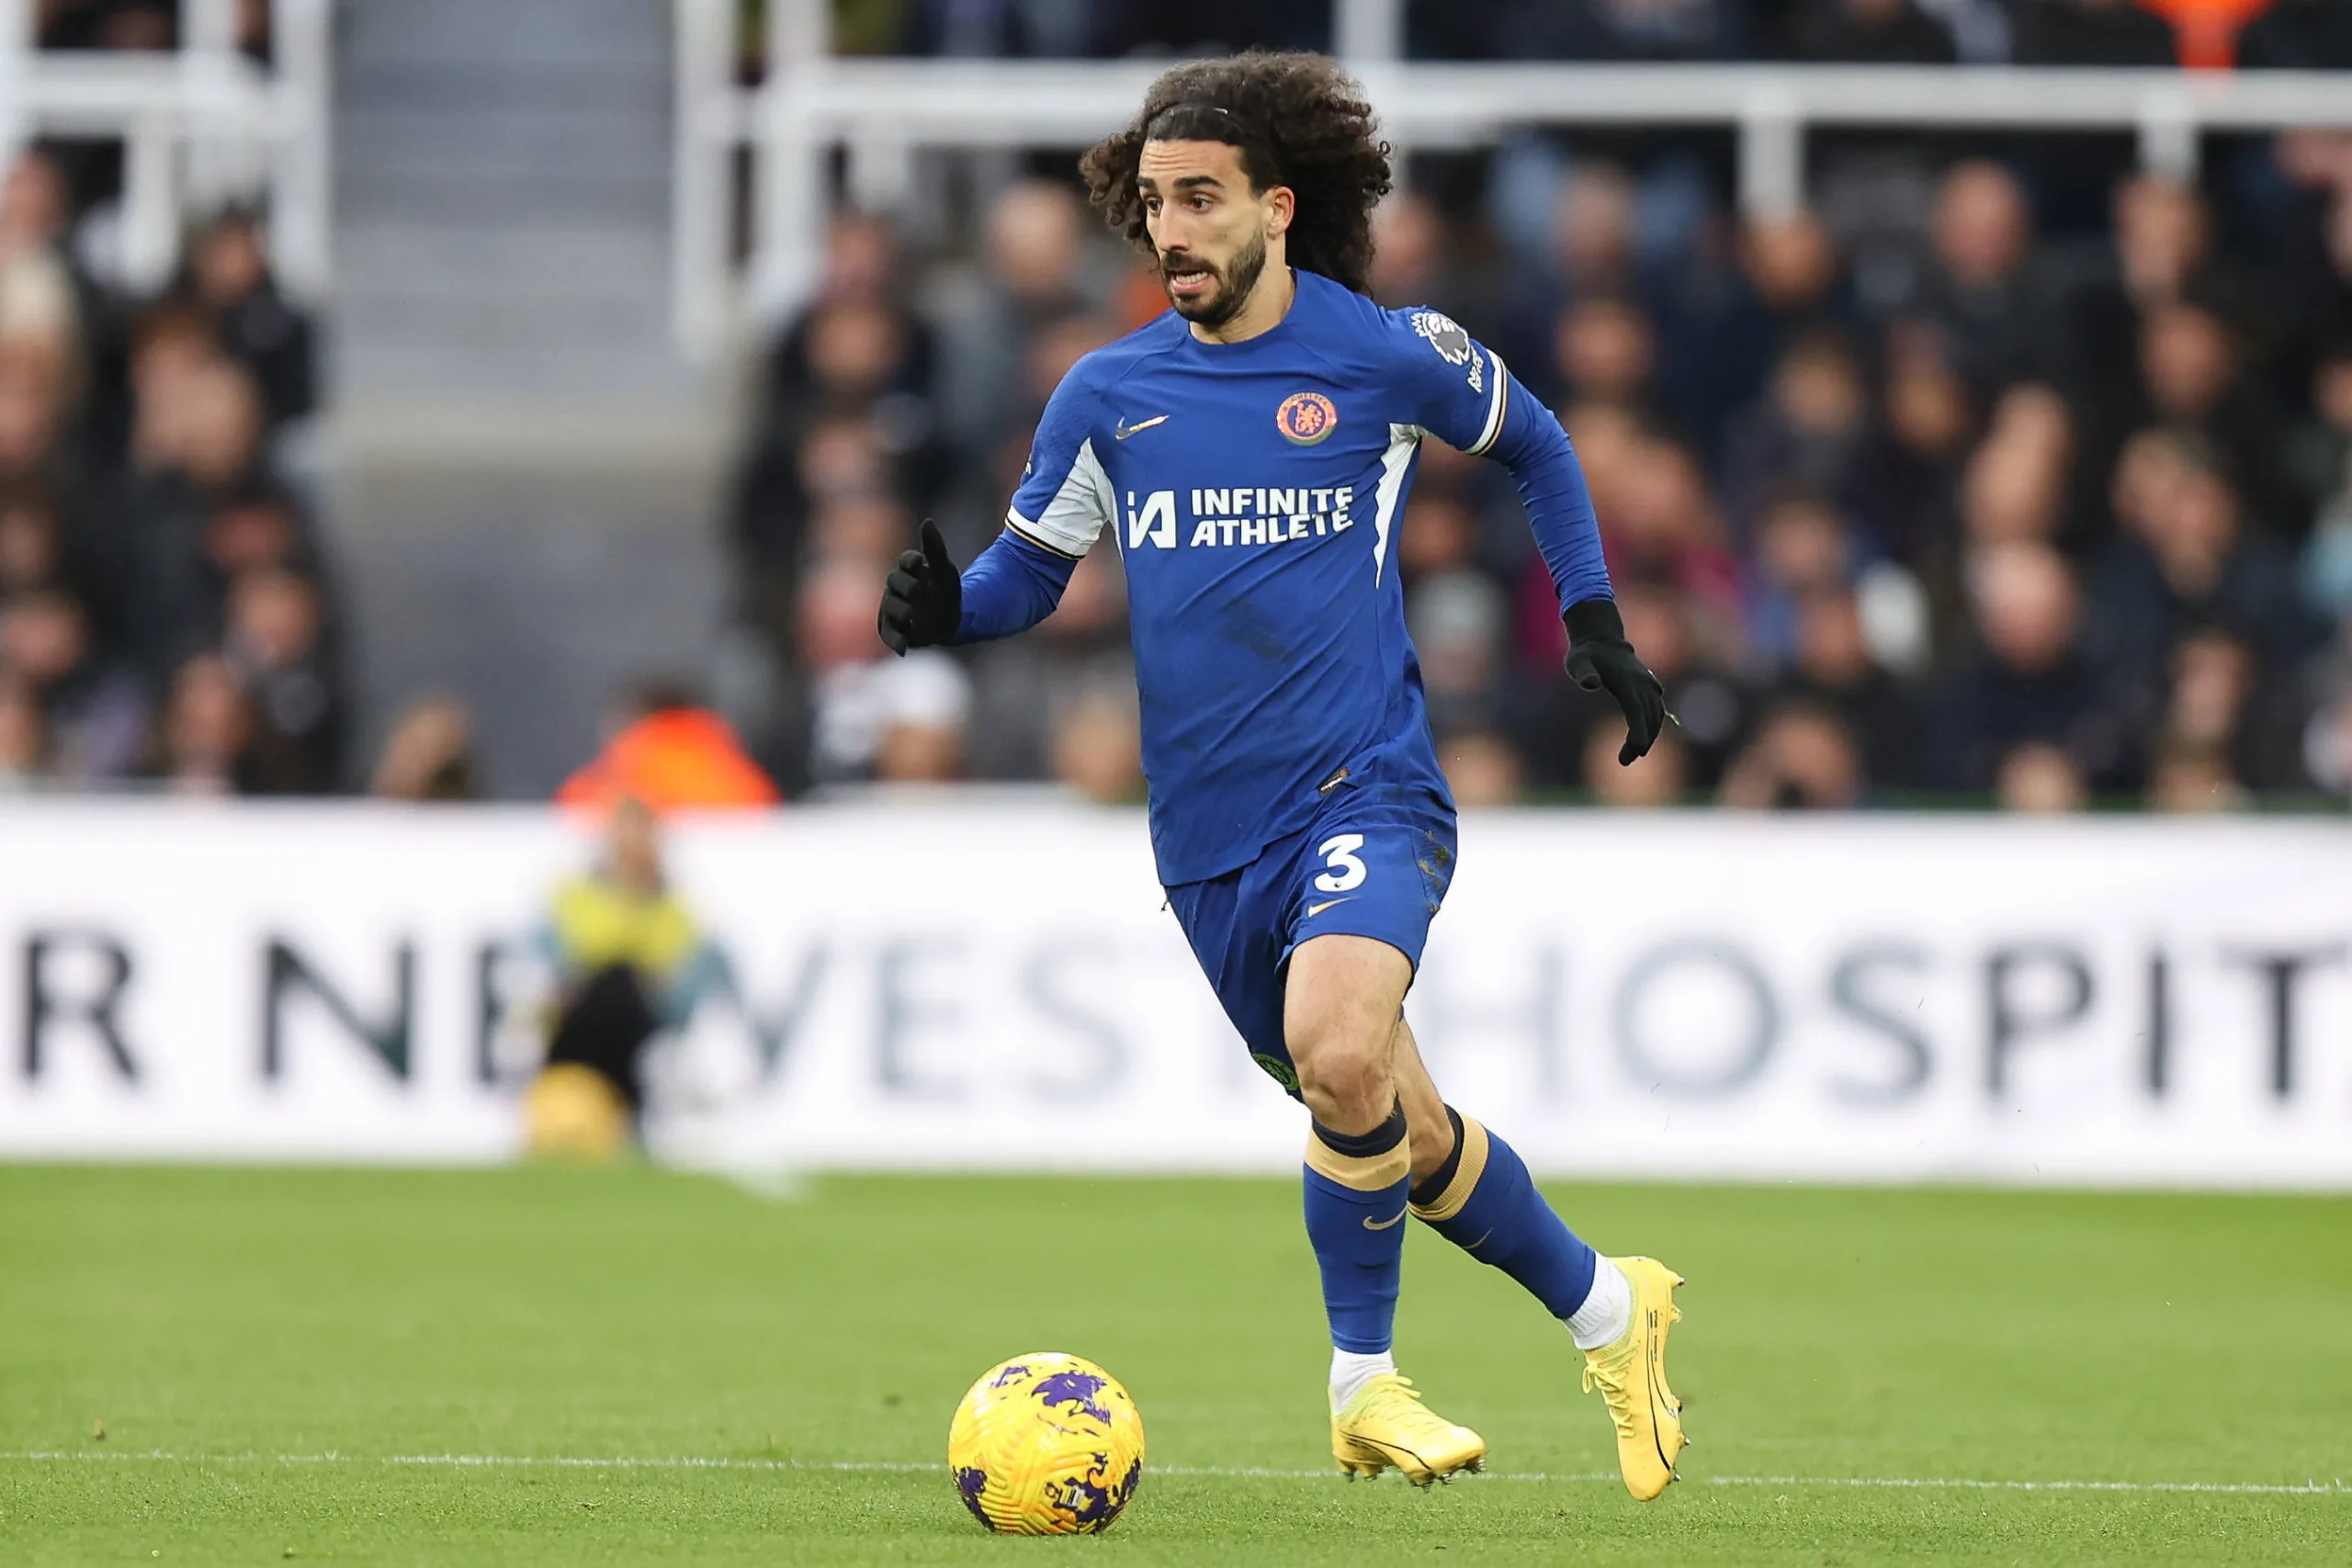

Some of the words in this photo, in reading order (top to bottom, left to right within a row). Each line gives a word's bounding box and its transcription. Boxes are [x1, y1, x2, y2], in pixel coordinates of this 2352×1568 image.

[1192, 487, 1352, 515] INFINITE
[1190, 506, 1353, 547] ATHLETE
[1314, 833, 1367, 892] 3
[20, 922, 140, 1086] R
[1422, 931, 2351, 1100] HOSPIT
